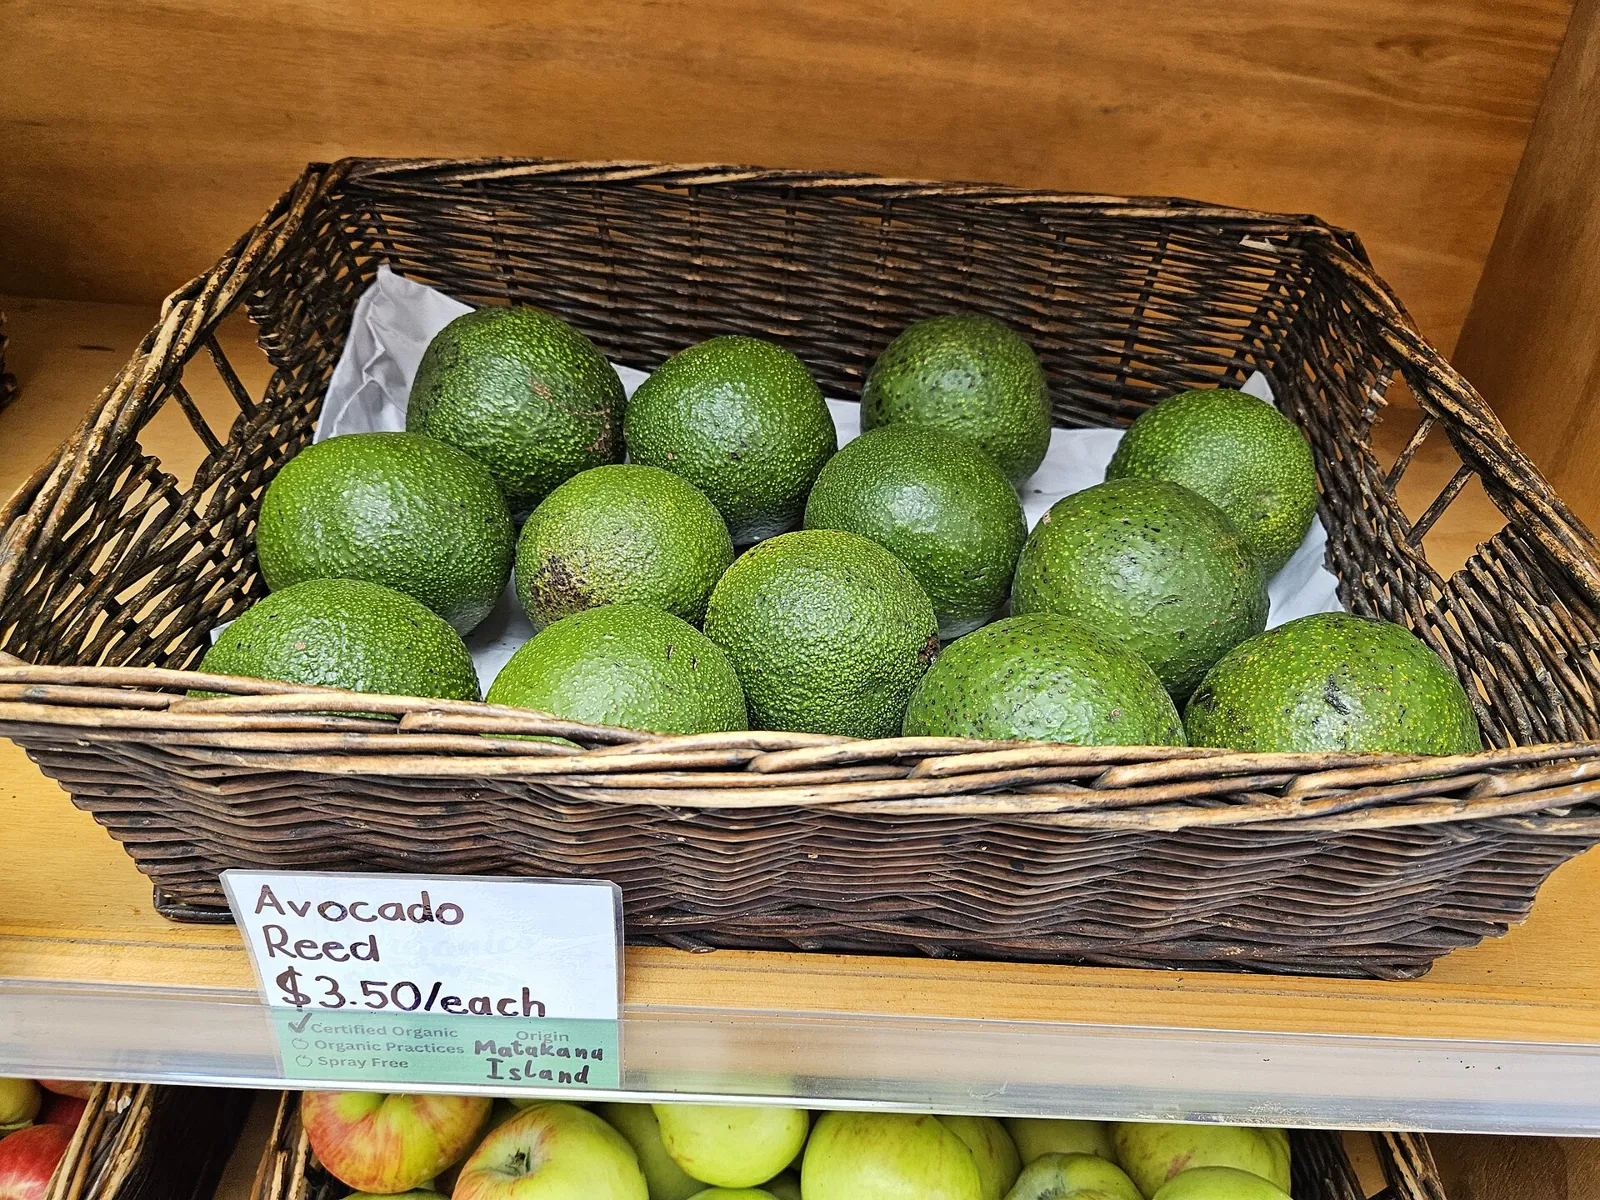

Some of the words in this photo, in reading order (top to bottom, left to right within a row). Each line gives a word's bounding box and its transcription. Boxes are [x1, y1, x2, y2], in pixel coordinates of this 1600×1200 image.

[255, 884, 464, 925] Avocado
[262, 924, 380, 962] Reed
[275, 965, 546, 1017] $3.50/each
[311, 1023, 387, 1036] Certified
[392, 1026, 458, 1039] Organic
[515, 1030, 570, 1043] Origin
[314, 1040, 381, 1052] Organic
[386, 1042, 465, 1054] Practices
[474, 1039, 603, 1061] Matakana
[317, 1056, 367, 1069] Spray
[372, 1057, 409, 1068] Free
[485, 1057, 590, 1084] Island
